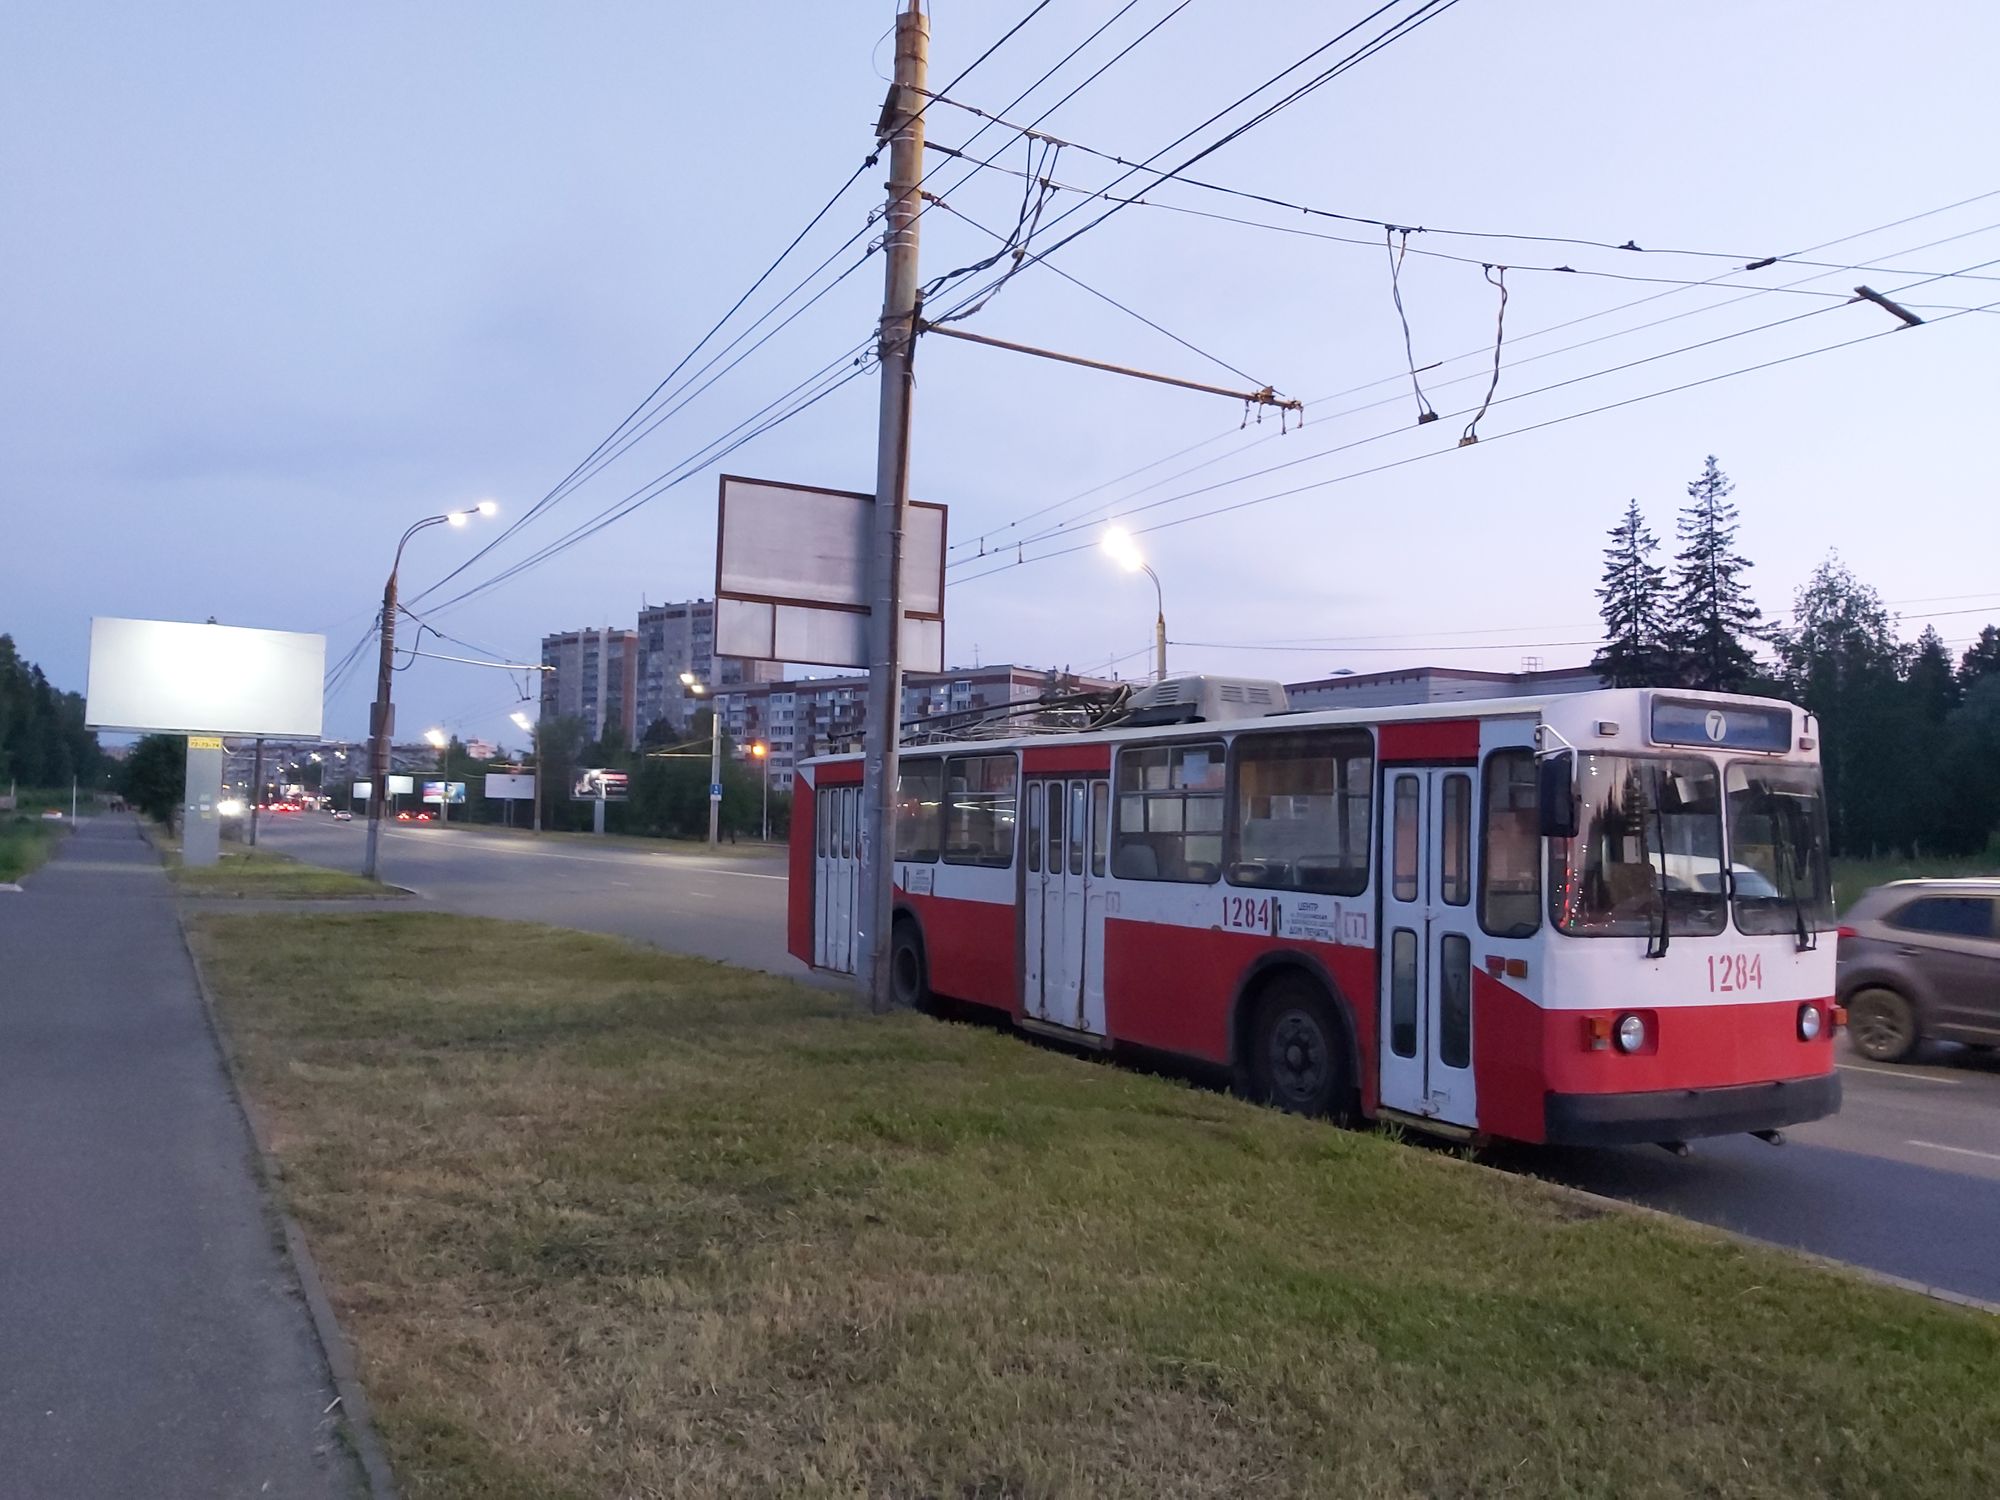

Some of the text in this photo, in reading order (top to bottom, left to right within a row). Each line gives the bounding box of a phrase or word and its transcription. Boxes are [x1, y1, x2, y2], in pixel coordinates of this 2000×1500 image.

[1710, 715, 1722, 739] 7
[1223, 896, 1268, 931] 1284
[1707, 953, 1762, 993] 1284
